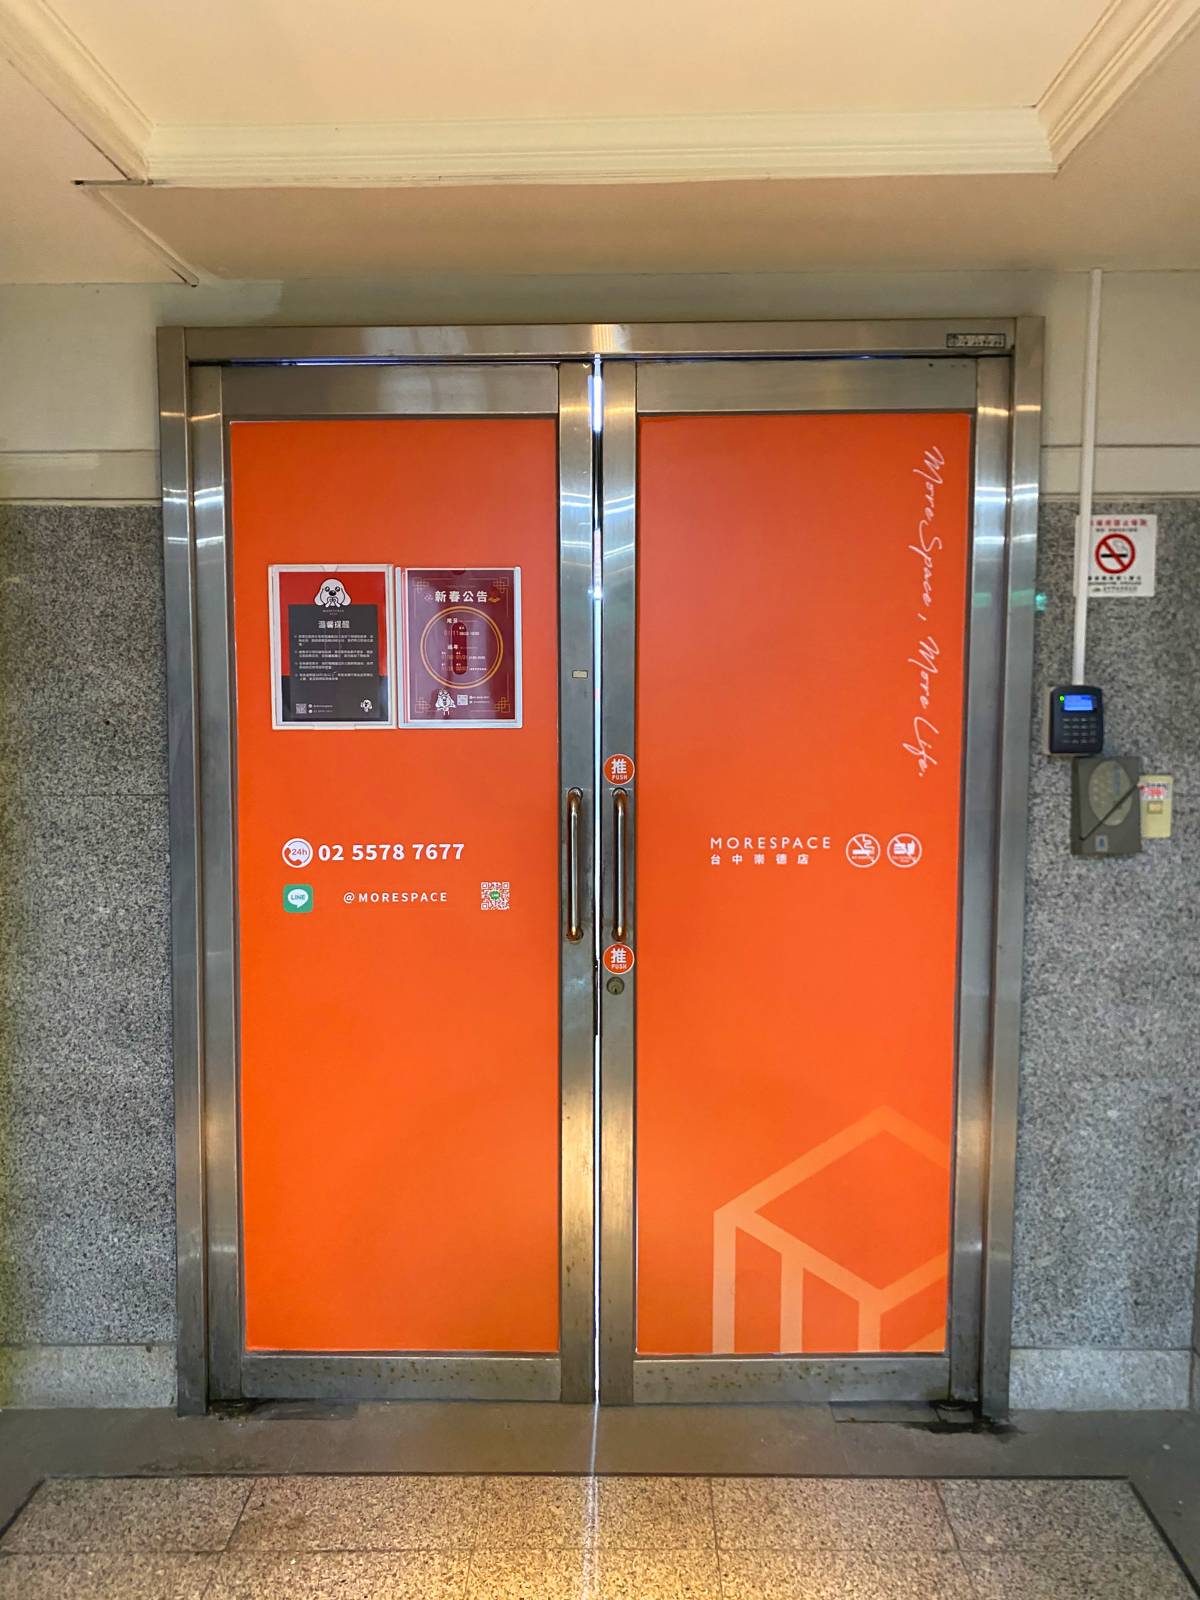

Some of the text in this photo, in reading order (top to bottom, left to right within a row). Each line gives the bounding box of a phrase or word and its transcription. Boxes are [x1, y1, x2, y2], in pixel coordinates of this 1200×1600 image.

[912, 445, 945, 519] More
[434, 590, 488, 603] 新春公告
[907, 635, 940, 709] More
[611, 758, 627, 774] 推
[710, 836, 831, 849] MORESPACE
[291, 847, 308, 856] 24h
[318, 843, 465, 861] 02 5578 7677
[343, 891, 448, 904] @MORESPACE
[611, 947, 627, 963] 推
